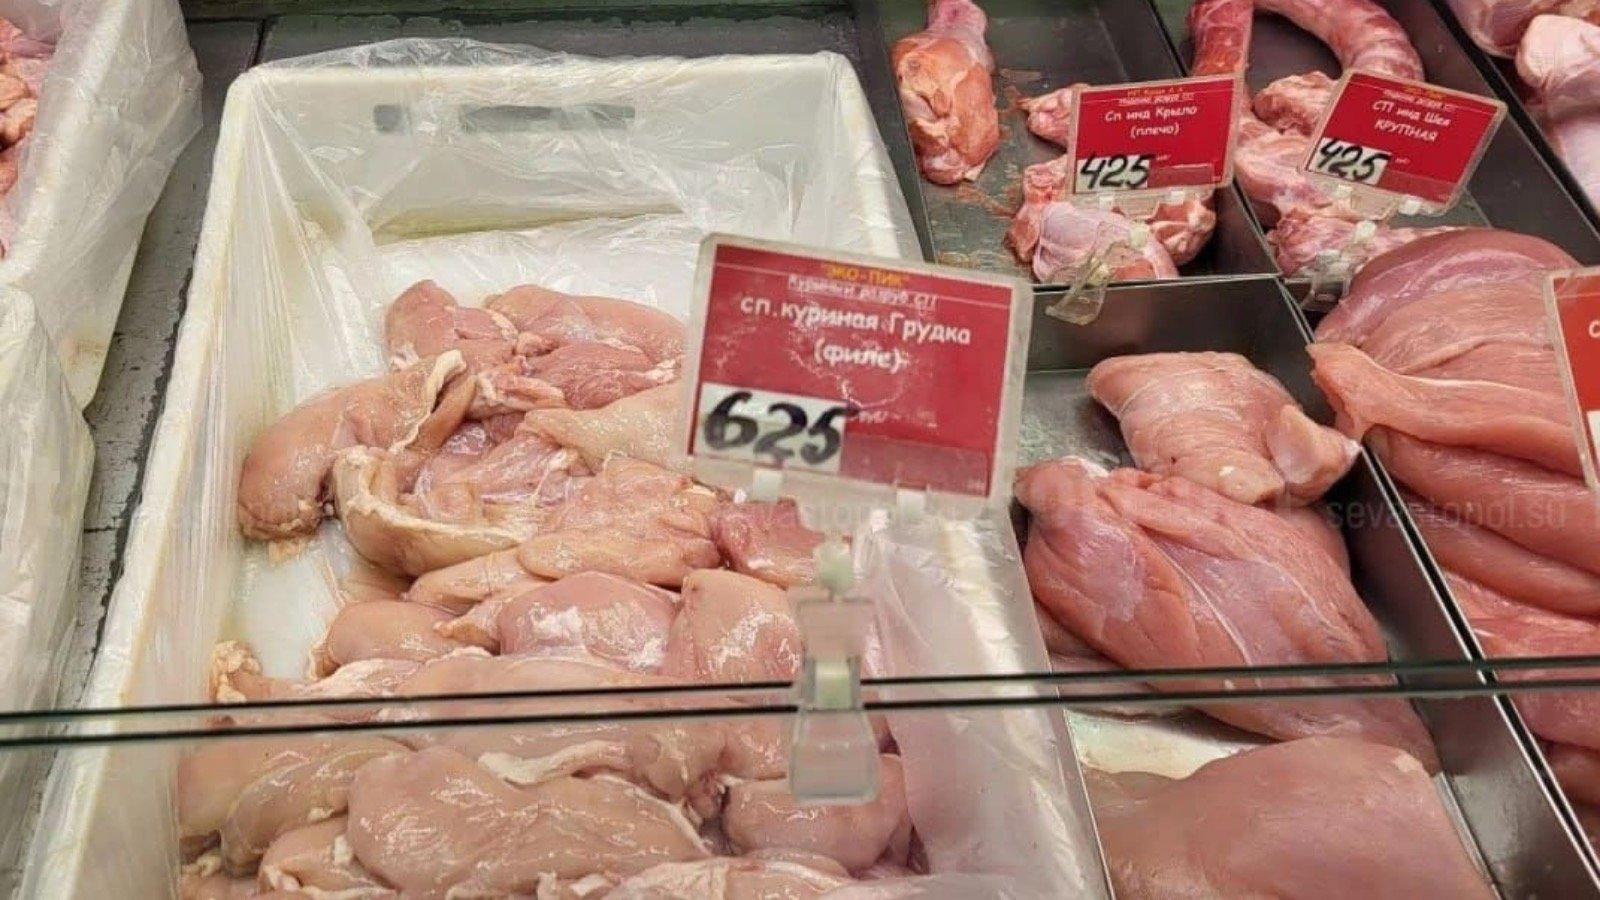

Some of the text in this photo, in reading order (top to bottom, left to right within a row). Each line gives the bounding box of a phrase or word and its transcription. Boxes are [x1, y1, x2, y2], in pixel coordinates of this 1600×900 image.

[1130, 122, 1180, 139] (плечо)
[1155, 105, 1198, 120] Крыло
[1080, 151, 1156, 189] 425
[1317, 137, 1391, 181] 425
[888, 311, 971, 345] Грудка
[703, 391, 860, 465] 625
